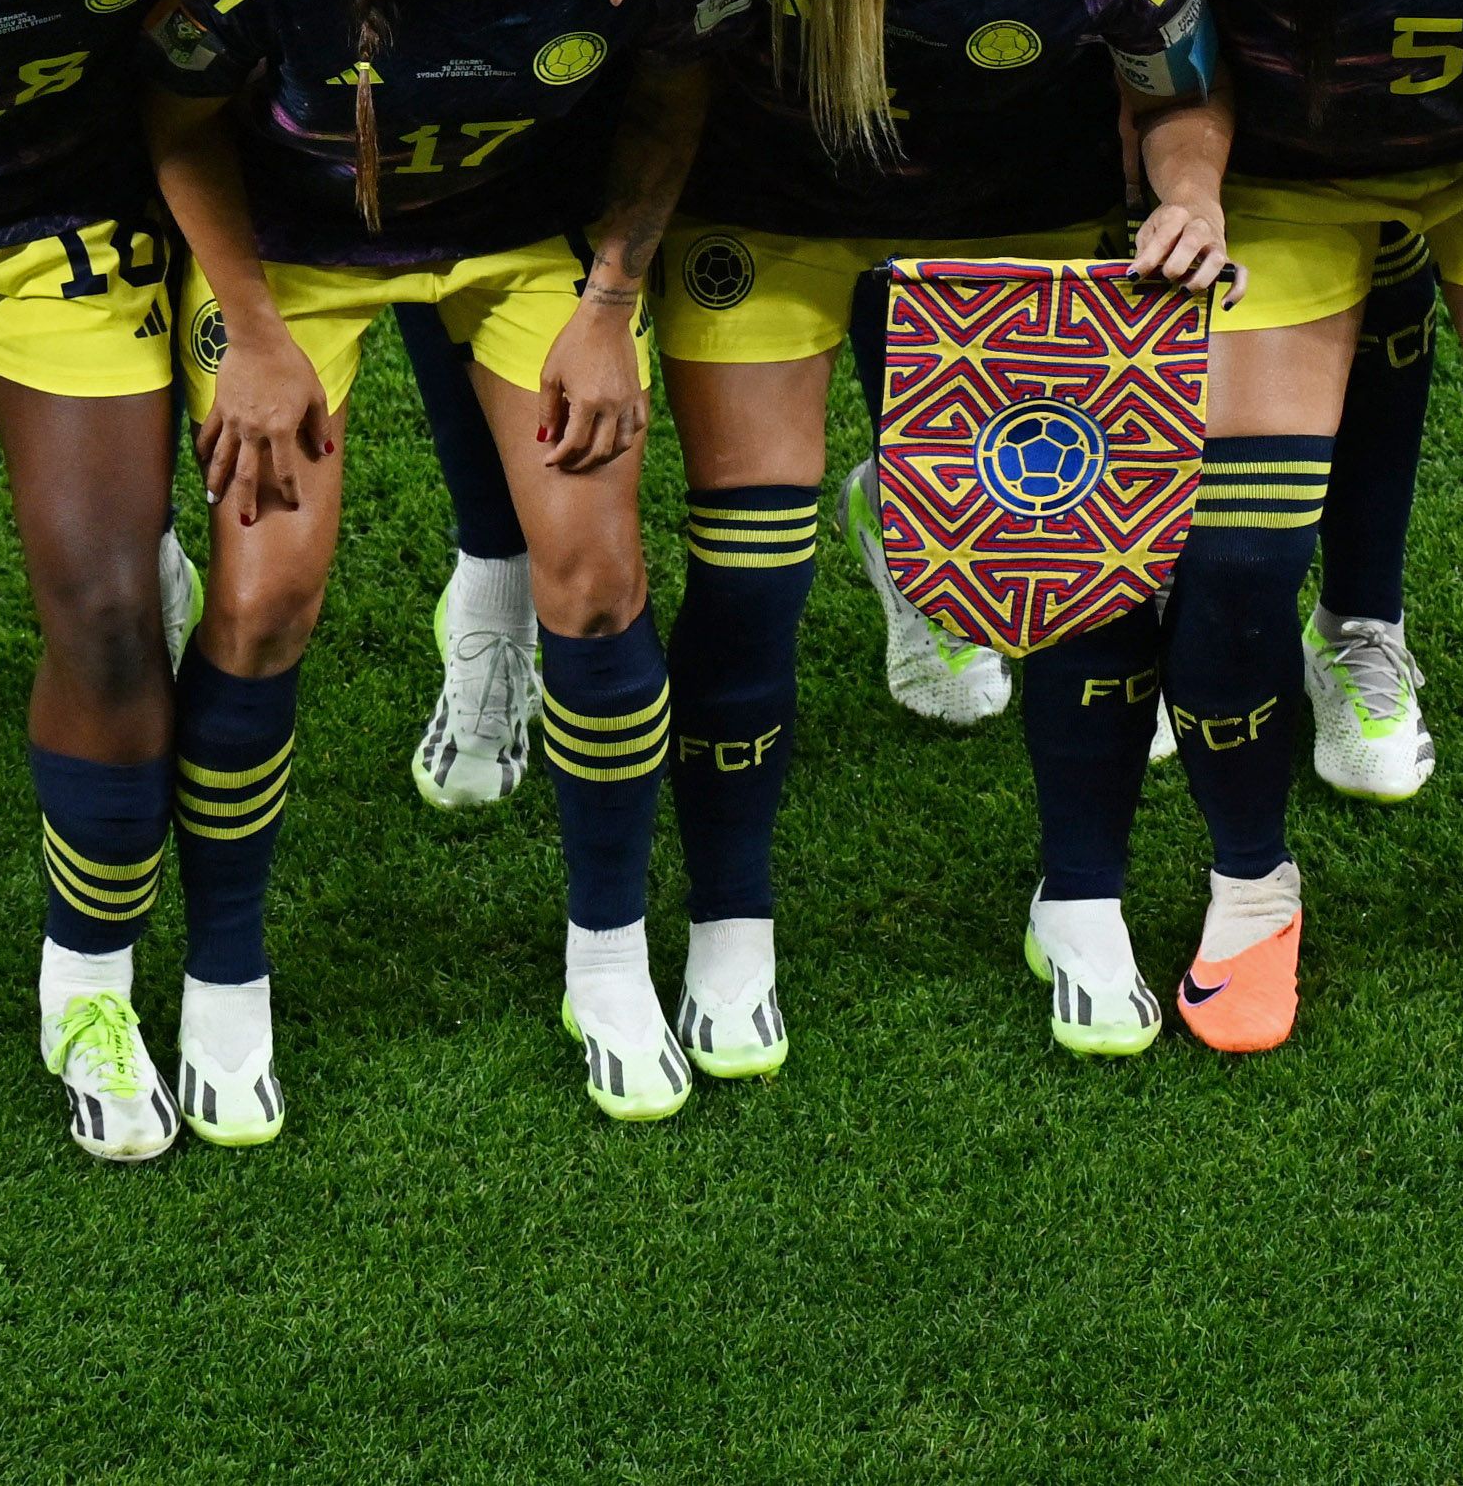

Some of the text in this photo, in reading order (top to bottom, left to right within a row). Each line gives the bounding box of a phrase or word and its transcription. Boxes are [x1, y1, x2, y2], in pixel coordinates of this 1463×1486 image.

[395, 118, 535, 173] 17
[1081, 668, 1155, 706] FC
[679, 724, 781, 772] FCF
[1173, 696, 1277, 751] FCF
